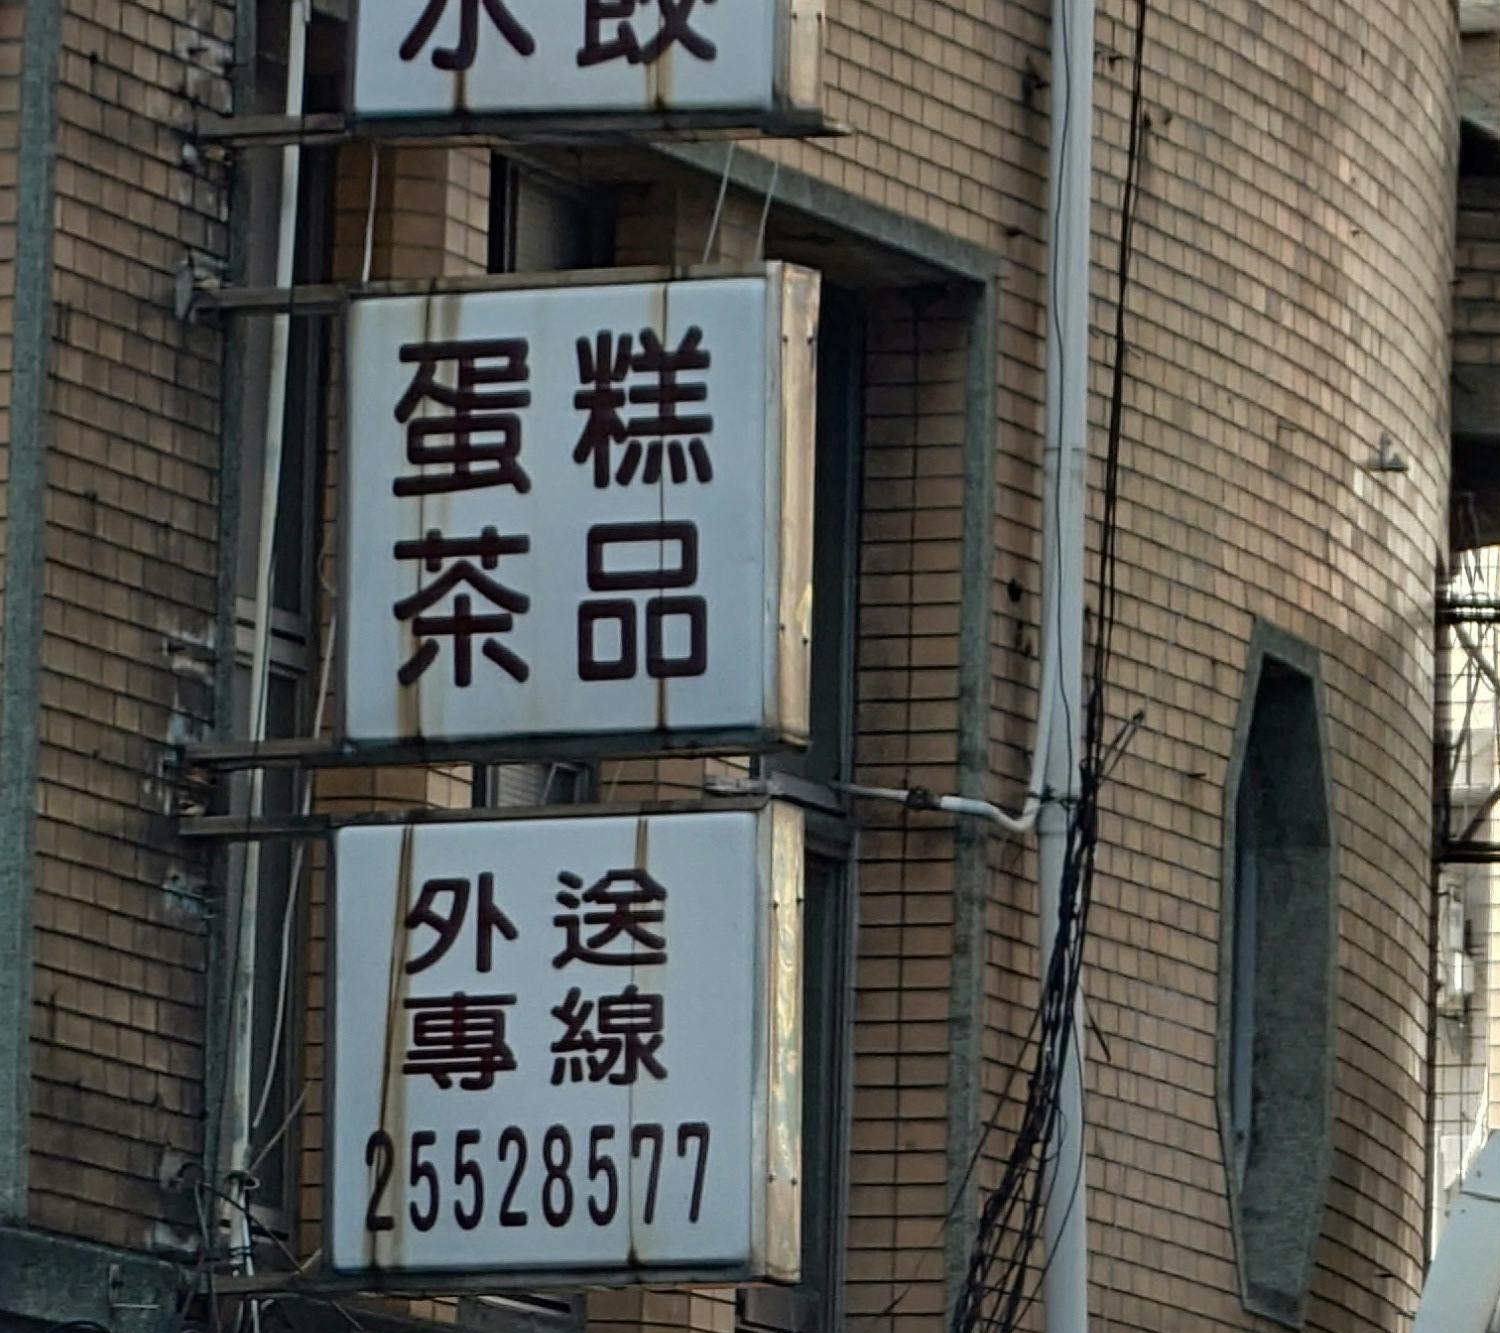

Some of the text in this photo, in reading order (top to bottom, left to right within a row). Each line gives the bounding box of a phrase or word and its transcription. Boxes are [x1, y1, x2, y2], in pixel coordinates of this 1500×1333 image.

[392, 327, 713, 498] 蛋糕
[392, 518, 708, 688] 茶品
[404, 868, 668, 975] 外送
[402, 985, 668, 1091] 專線
[365, 1121, 712, 1232] 25528577
